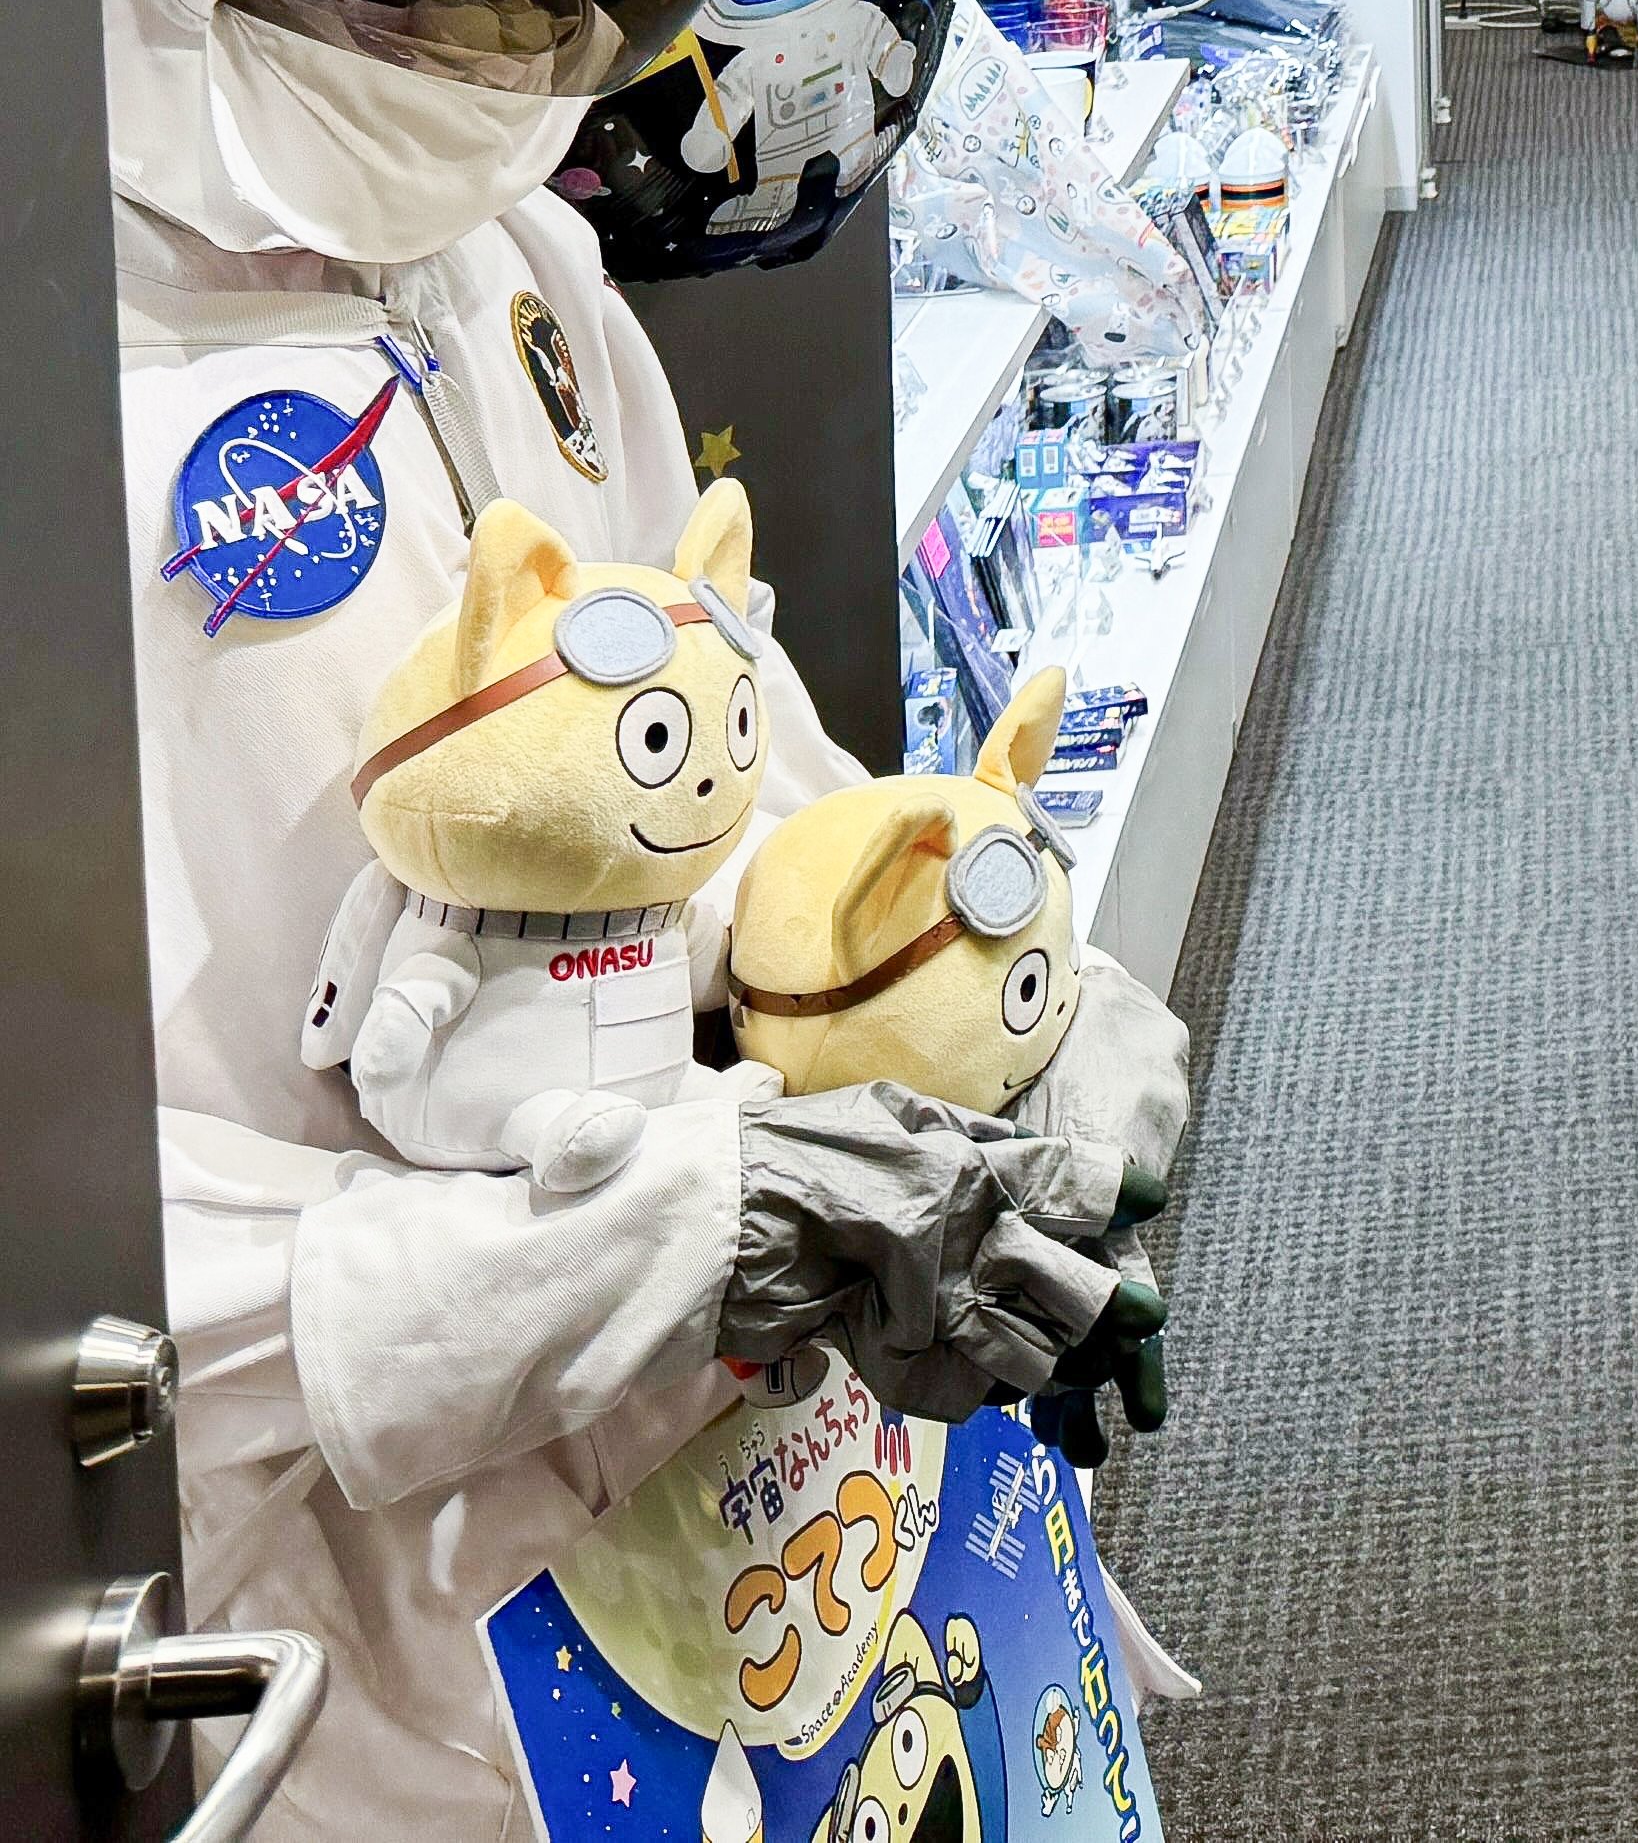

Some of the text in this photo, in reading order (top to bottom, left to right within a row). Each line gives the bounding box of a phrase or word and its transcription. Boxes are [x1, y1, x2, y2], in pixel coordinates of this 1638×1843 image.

[192, 465, 380, 551] NASA
[549, 938, 656, 982] ONASU
[719, 1372, 872, 1546] 宇宙なんちゃら
[838, 1621, 881, 1697] Academy
